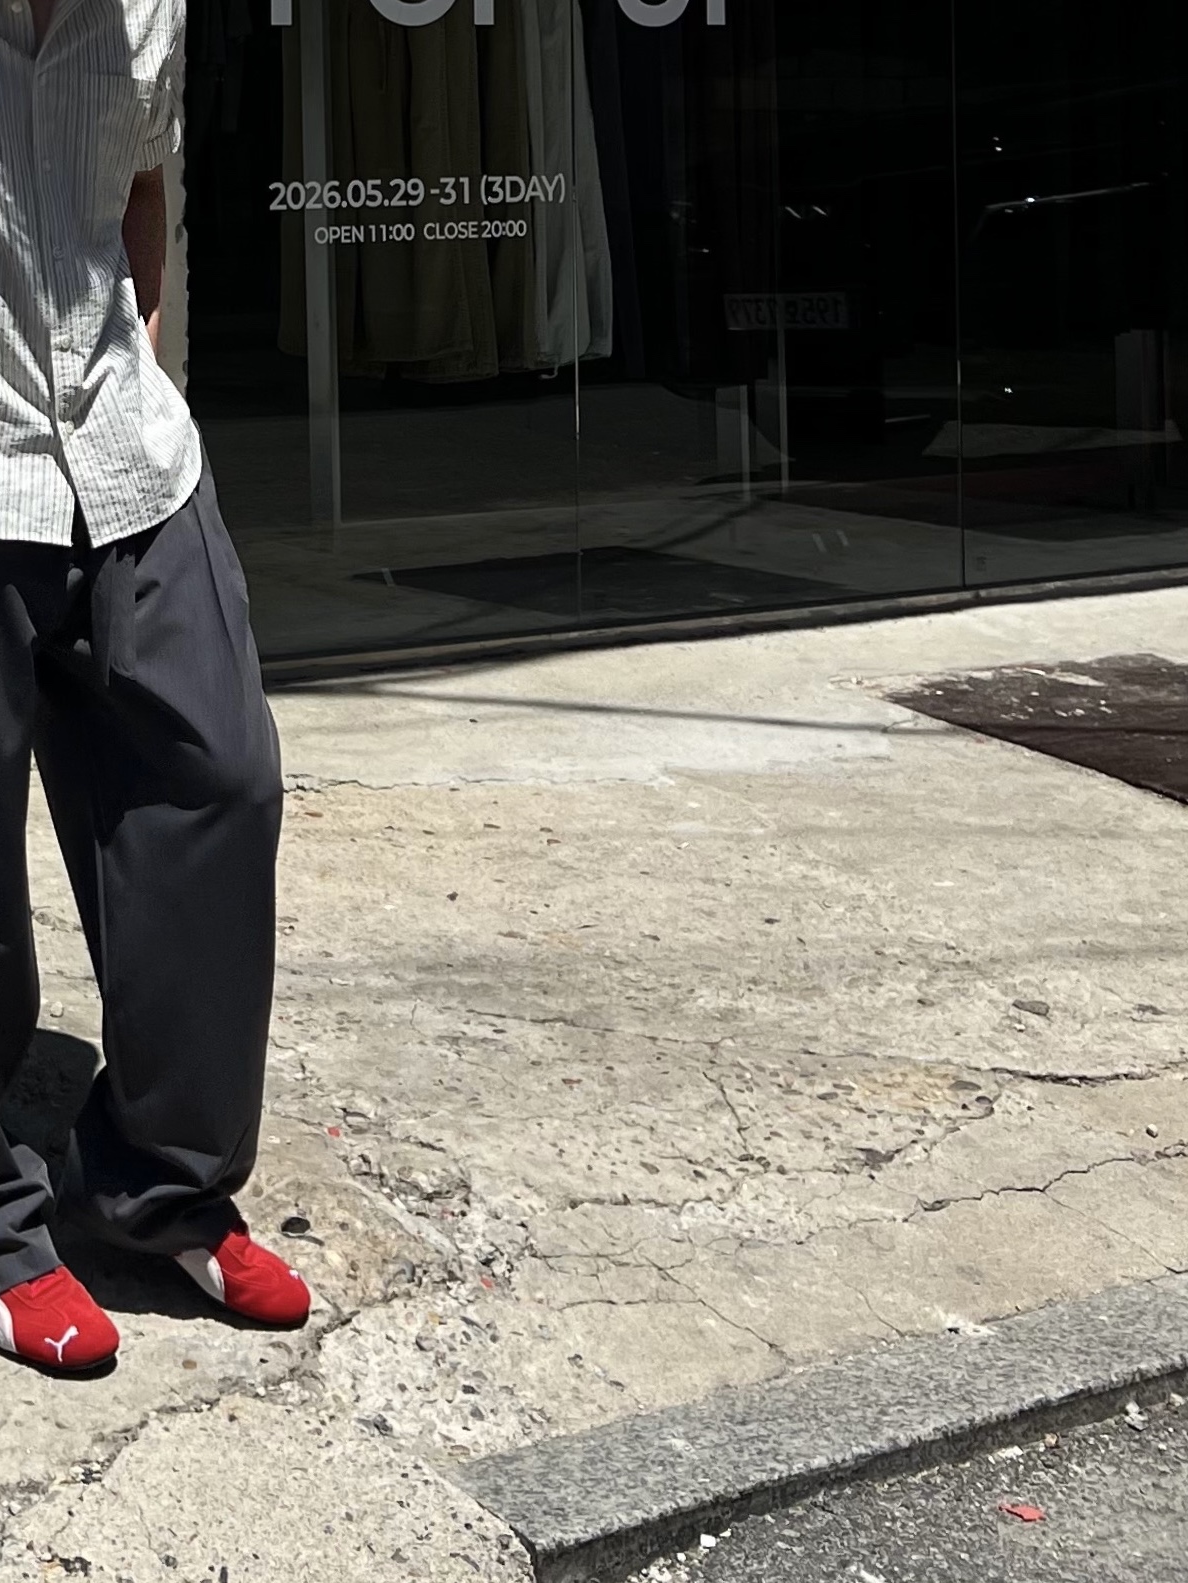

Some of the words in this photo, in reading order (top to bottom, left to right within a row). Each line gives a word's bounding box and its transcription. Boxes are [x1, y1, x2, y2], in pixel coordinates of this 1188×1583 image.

[269, 178, 425, 210] 2026.05.29
[480, 173, 566, 205] (3DAY)
[314, 225, 364, 244] OPEN
[369, 223, 415, 243] 11:00
[423, 221, 479, 240] CLOSE
[481, 220, 527, 238] 20:00
